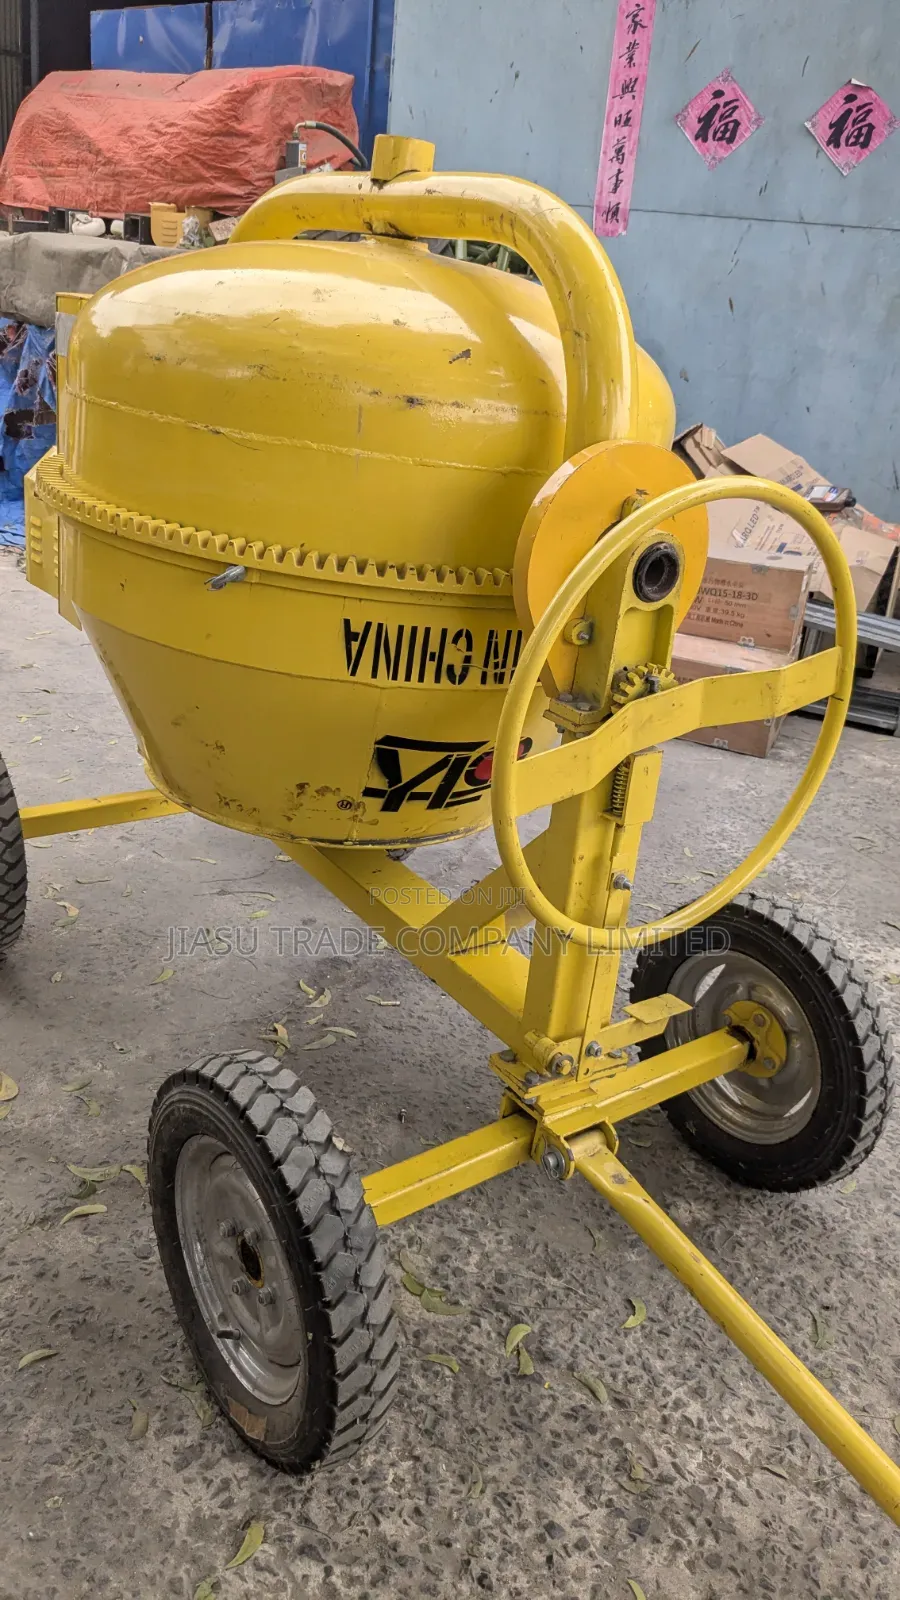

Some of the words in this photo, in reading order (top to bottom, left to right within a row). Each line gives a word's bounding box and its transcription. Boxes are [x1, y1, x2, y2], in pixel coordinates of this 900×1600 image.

[694, 89, 742, 144] 福
[826, 93, 876, 149] 福
[343, 618, 473, 686] CHINA
